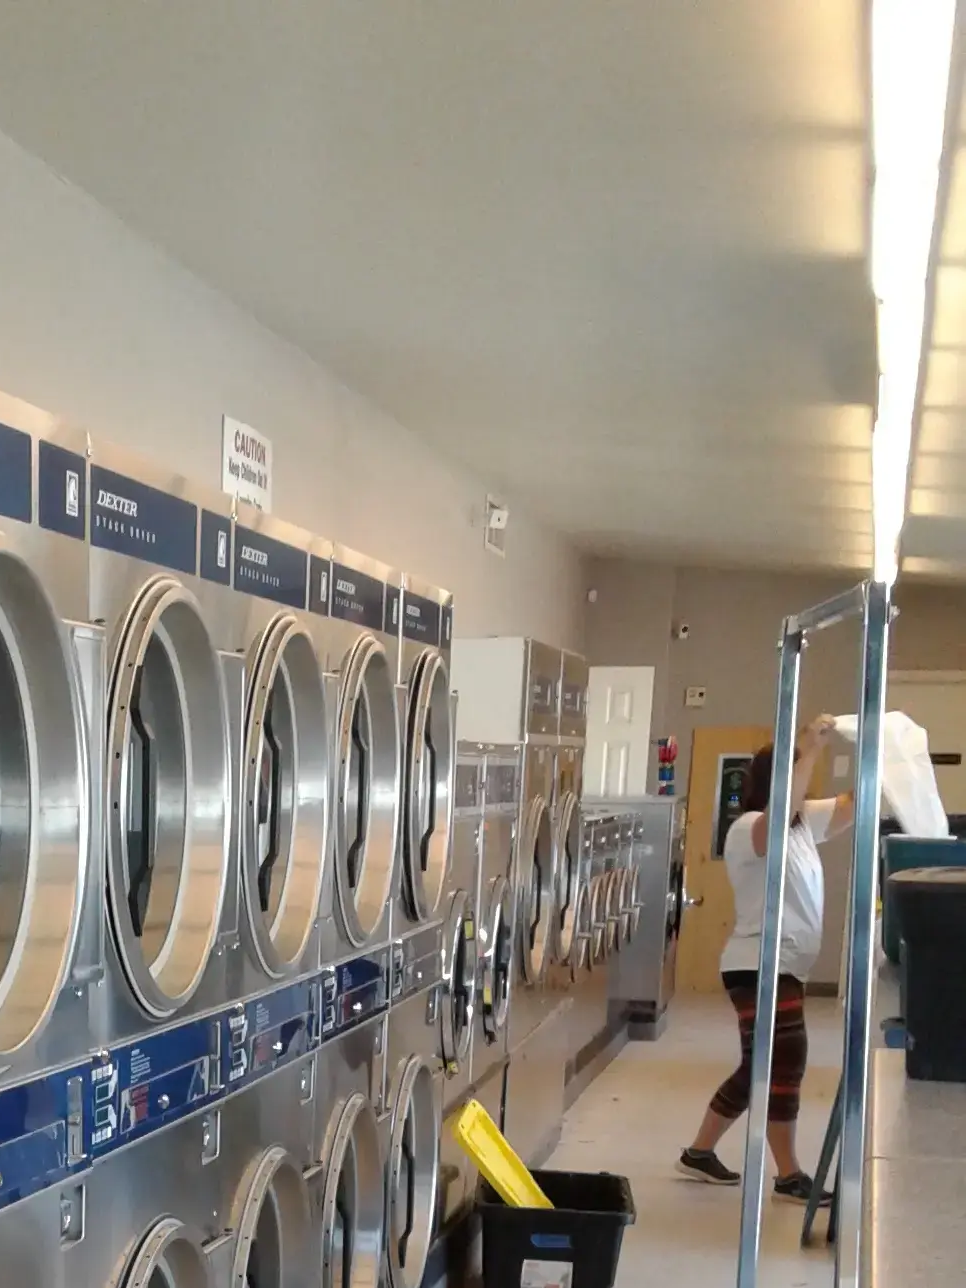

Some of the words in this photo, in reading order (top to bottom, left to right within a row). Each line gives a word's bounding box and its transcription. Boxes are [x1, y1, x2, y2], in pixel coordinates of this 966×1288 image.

[234, 429, 266, 467] CAUTION
[96, 489, 138, 518] DEXTER
[241, 545, 268, 566] DEXTER
